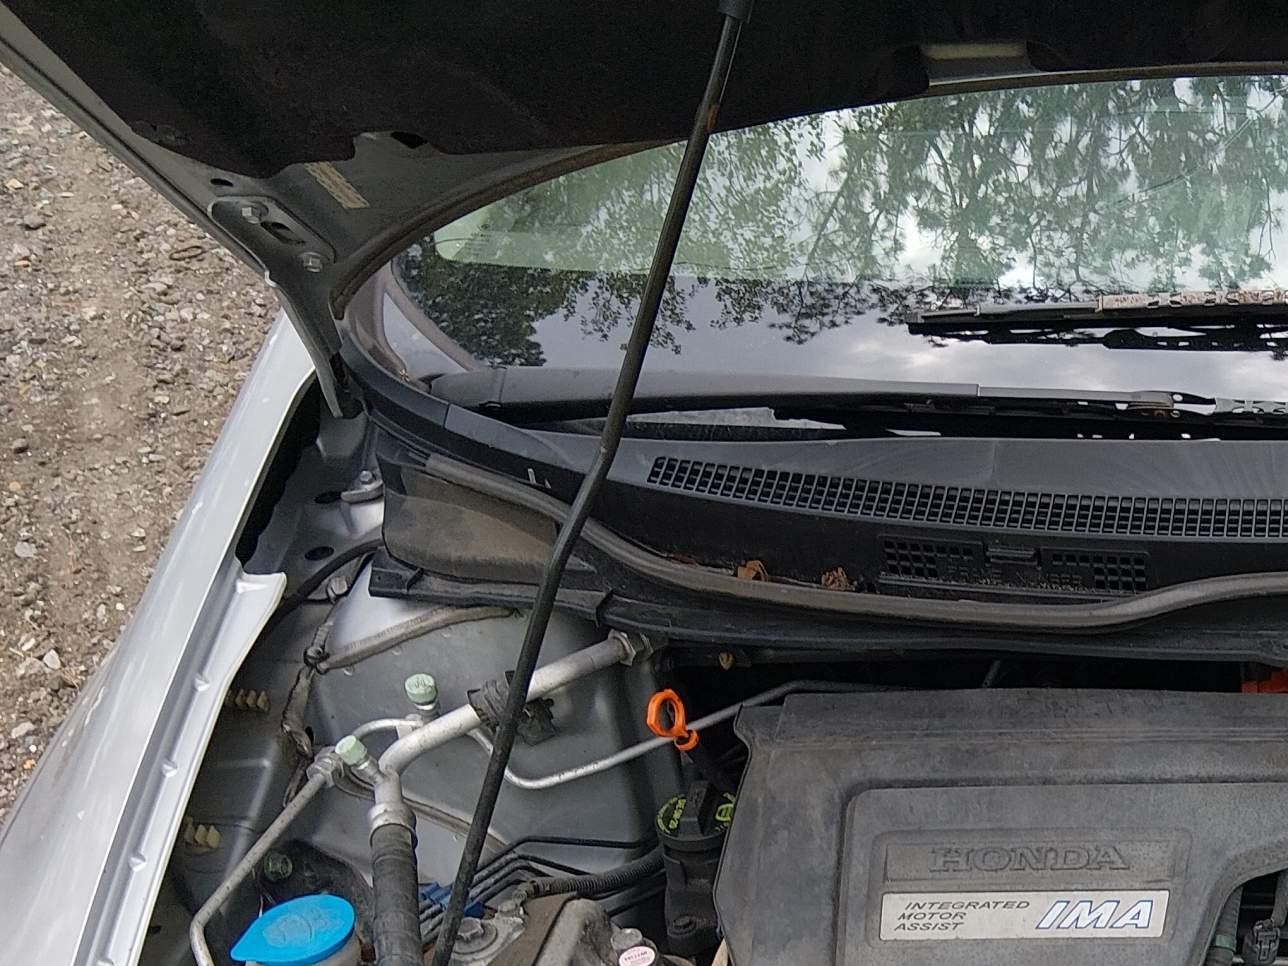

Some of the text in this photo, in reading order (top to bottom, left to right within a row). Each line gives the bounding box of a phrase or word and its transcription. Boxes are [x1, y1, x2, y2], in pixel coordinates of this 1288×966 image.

[929, 846, 1131, 872] HONDA
[905, 901, 1030, 910] INTEGRATED
[898, 912, 967, 921] MOTOR
[1035, 900, 1154, 930] IMA
[894, 922, 965, 931] ASSIST
